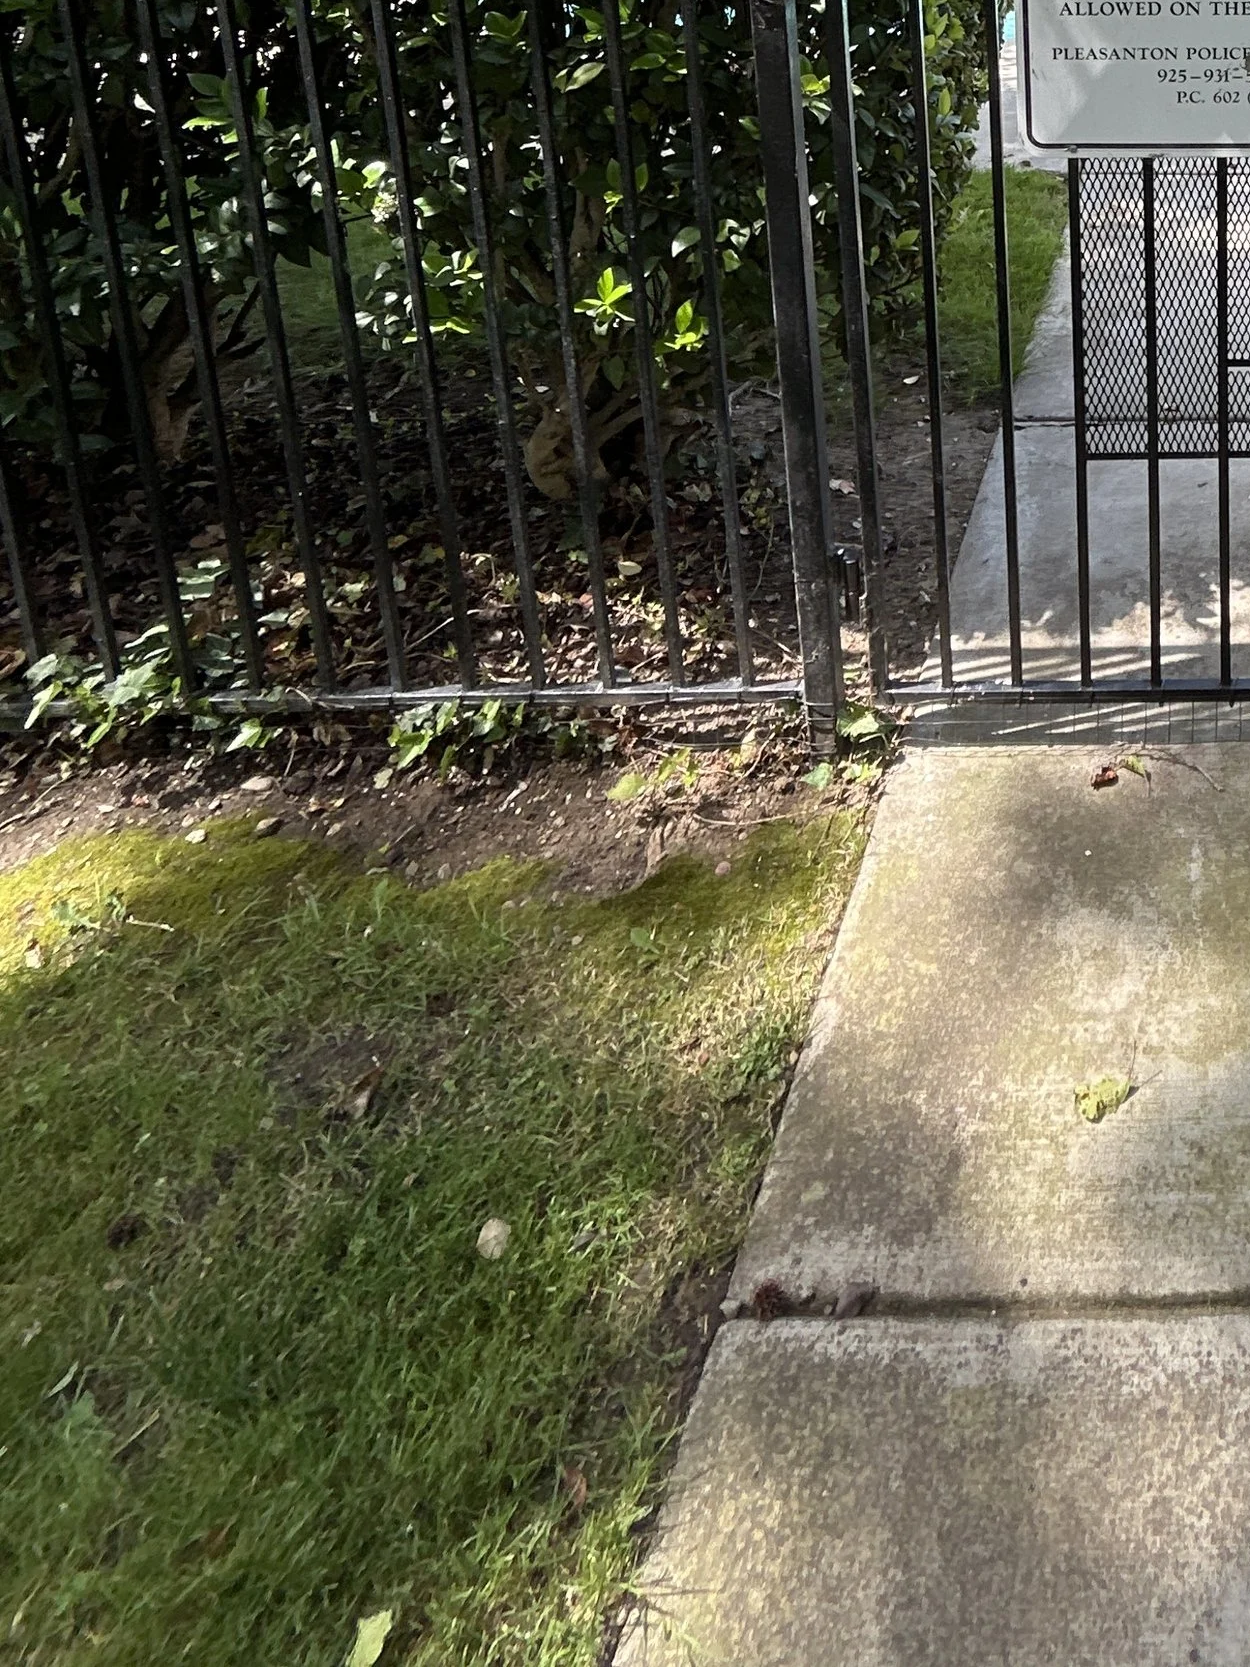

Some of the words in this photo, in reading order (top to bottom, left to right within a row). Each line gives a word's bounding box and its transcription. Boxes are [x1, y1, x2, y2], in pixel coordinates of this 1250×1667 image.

[1060, 2, 1161, 16] ALLOWED
[1170, 2, 1200, 16] ON
[1052, 47, 1178, 60] PLEASANTON
[1177, 91, 1205, 103] P.C.
[1213, 90, 1240, 103] 602
